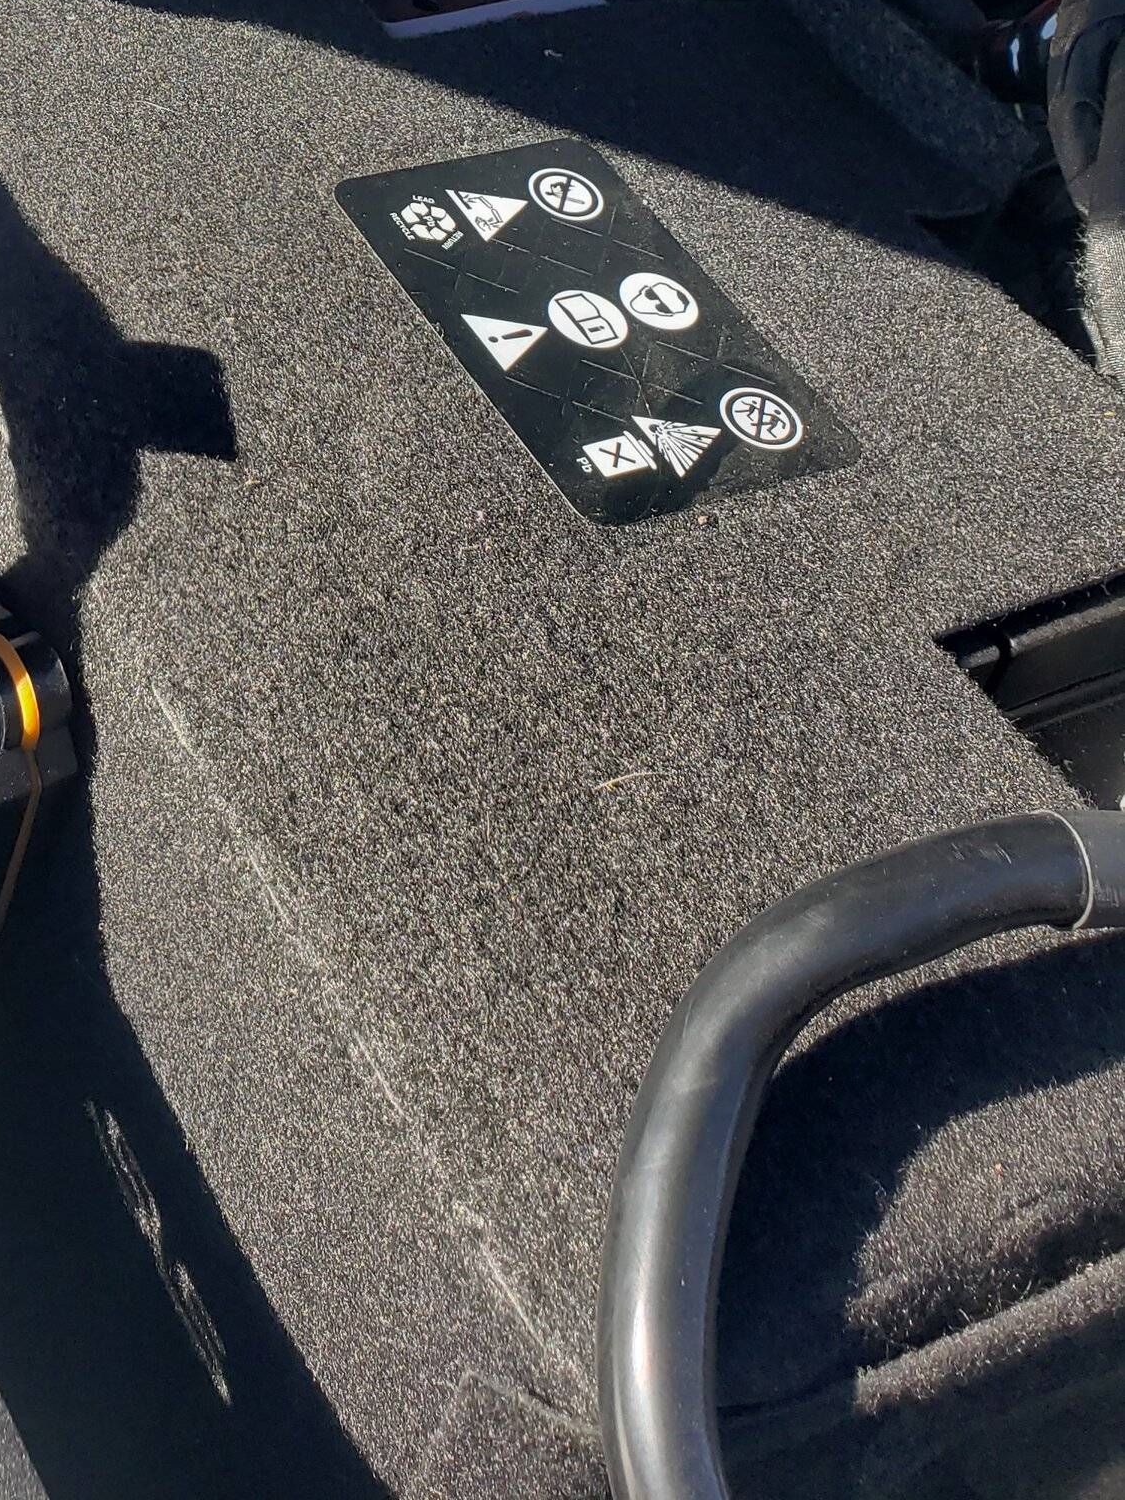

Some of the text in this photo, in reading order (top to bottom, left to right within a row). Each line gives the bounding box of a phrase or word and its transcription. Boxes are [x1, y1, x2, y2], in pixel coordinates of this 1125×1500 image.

[412, 194, 436, 205] LEAD
[389, 212, 416, 241] RECYCLE
[422, 215, 436, 227] Pb
[576, 456, 593, 473] Pb
